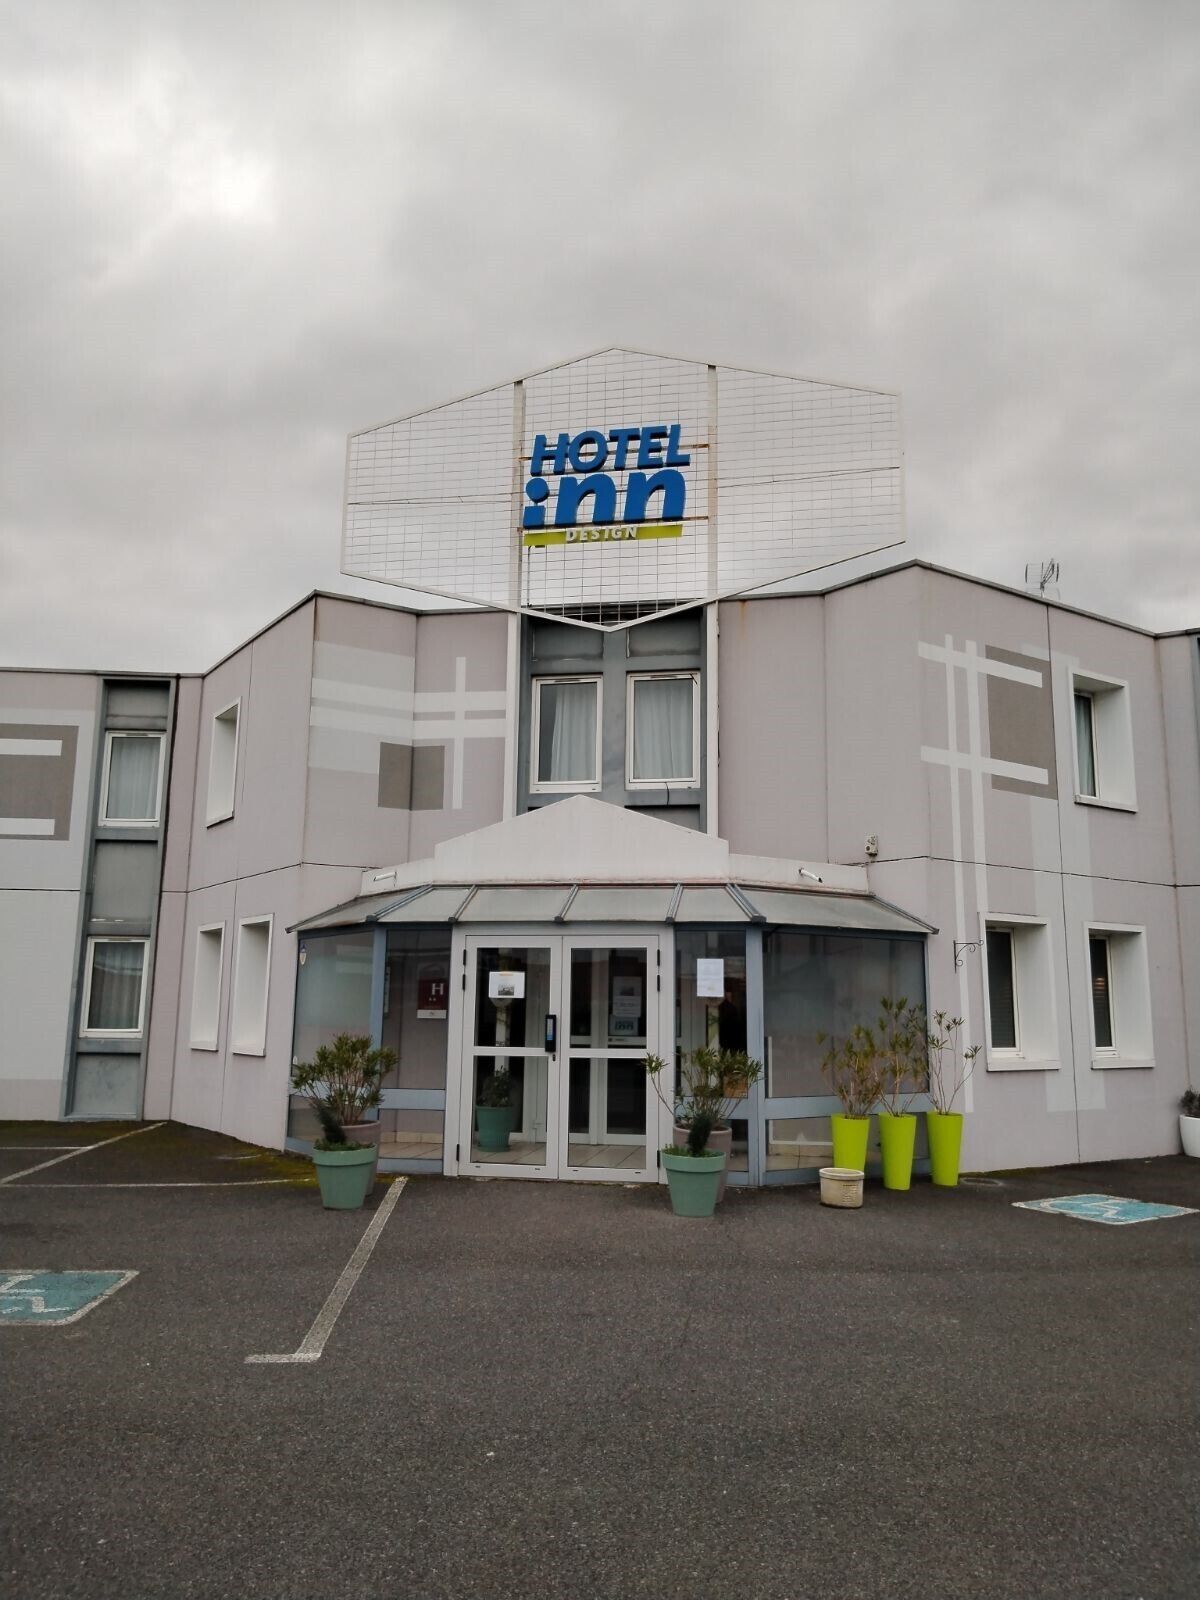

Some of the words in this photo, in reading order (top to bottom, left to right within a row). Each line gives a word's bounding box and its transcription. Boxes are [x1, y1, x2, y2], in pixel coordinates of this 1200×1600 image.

[530, 424, 690, 476] HOTEL
[523, 469, 686, 529] inn
[566, 527, 637, 543] DESIGN
[431, 983, 444, 995] H
